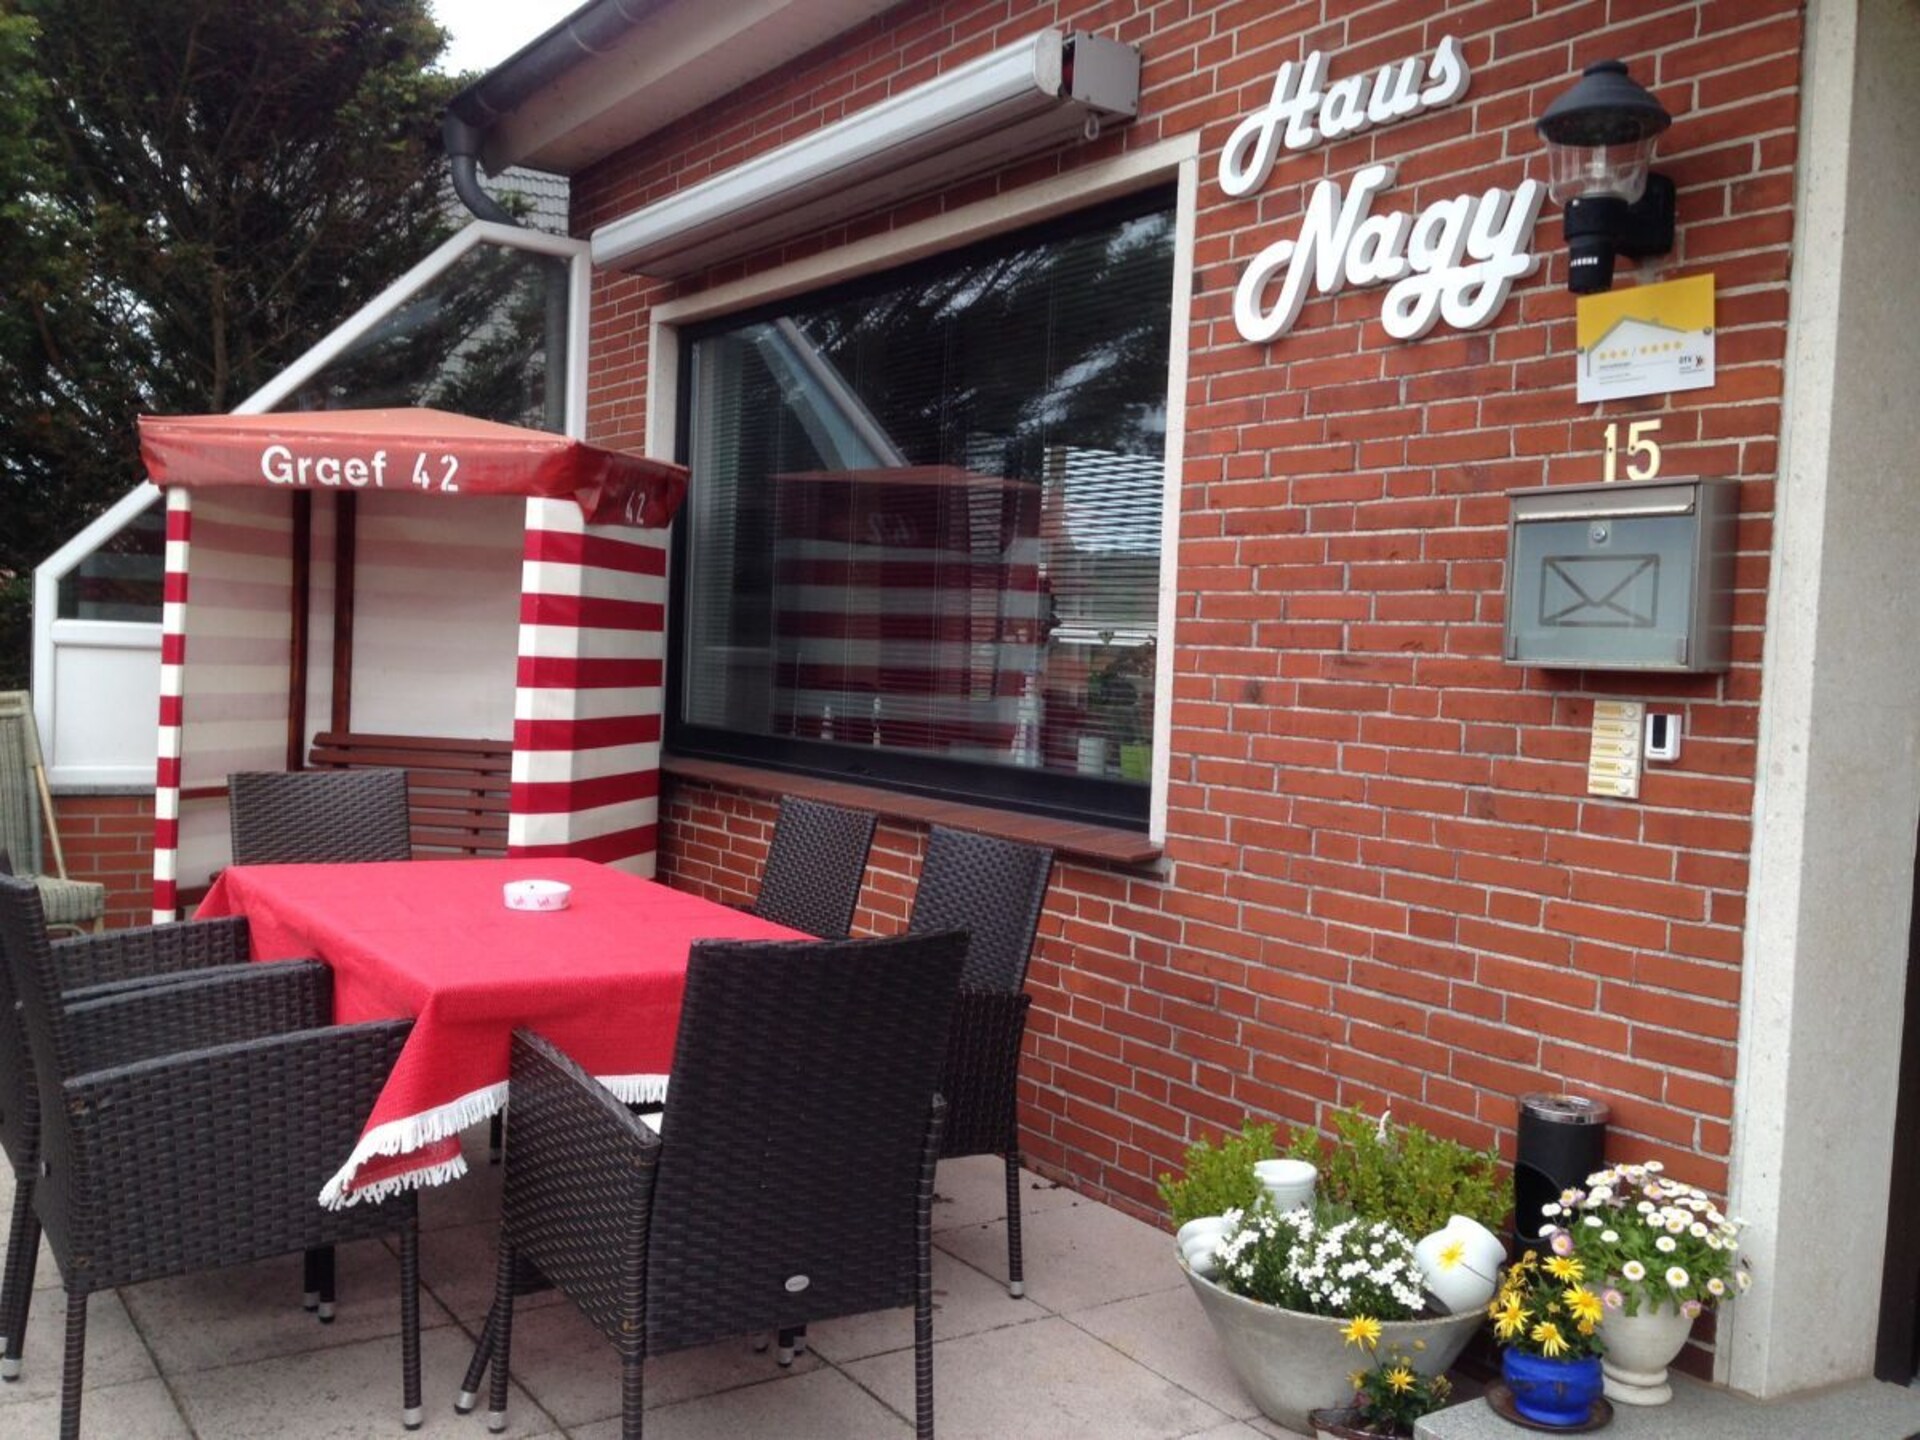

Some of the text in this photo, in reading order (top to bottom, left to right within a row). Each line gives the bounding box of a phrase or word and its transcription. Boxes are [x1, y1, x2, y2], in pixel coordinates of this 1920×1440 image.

[1218, 35, 1470, 196] Haus
[1233, 164, 1550, 342] Nagy
[261, 445, 459, 492] Graef 42
[1603, 419, 1662, 482] 15
[625, 490, 646, 525] 42
